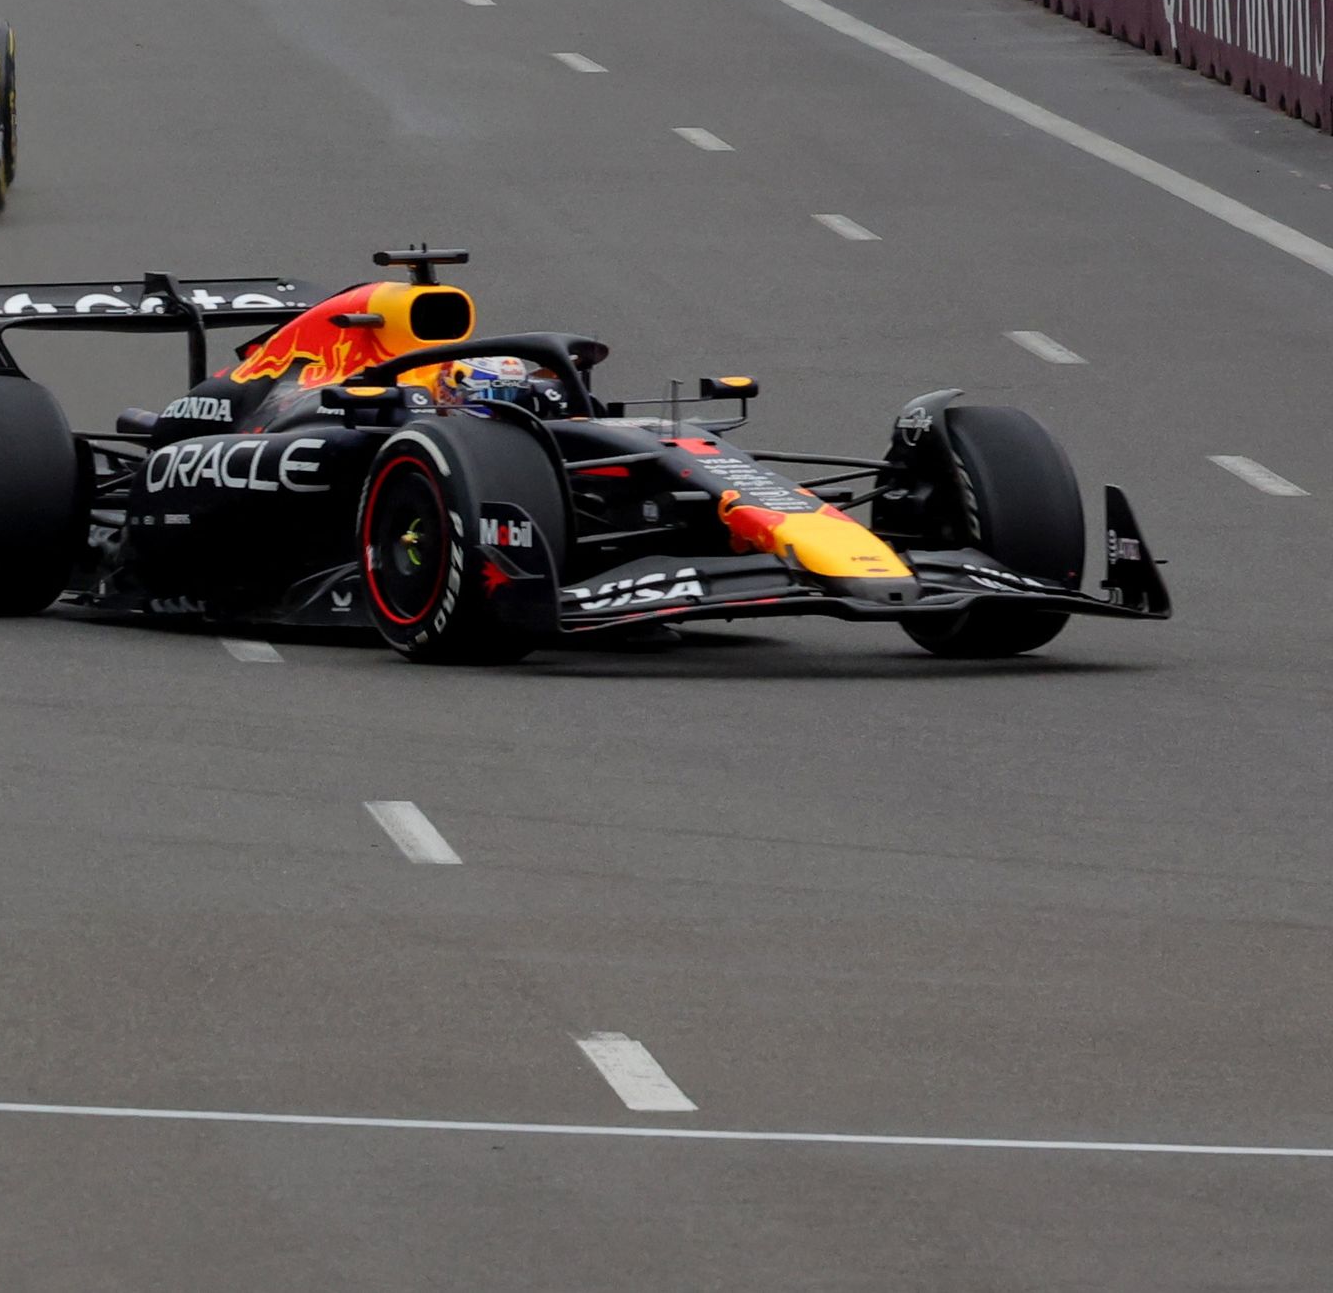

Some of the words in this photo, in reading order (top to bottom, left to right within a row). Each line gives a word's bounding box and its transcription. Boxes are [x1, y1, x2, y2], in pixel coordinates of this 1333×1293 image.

[160, 396, 234, 423] HONDA
[146, 438, 331, 494] ORACLE
[478, 517, 533, 548] Mobil
